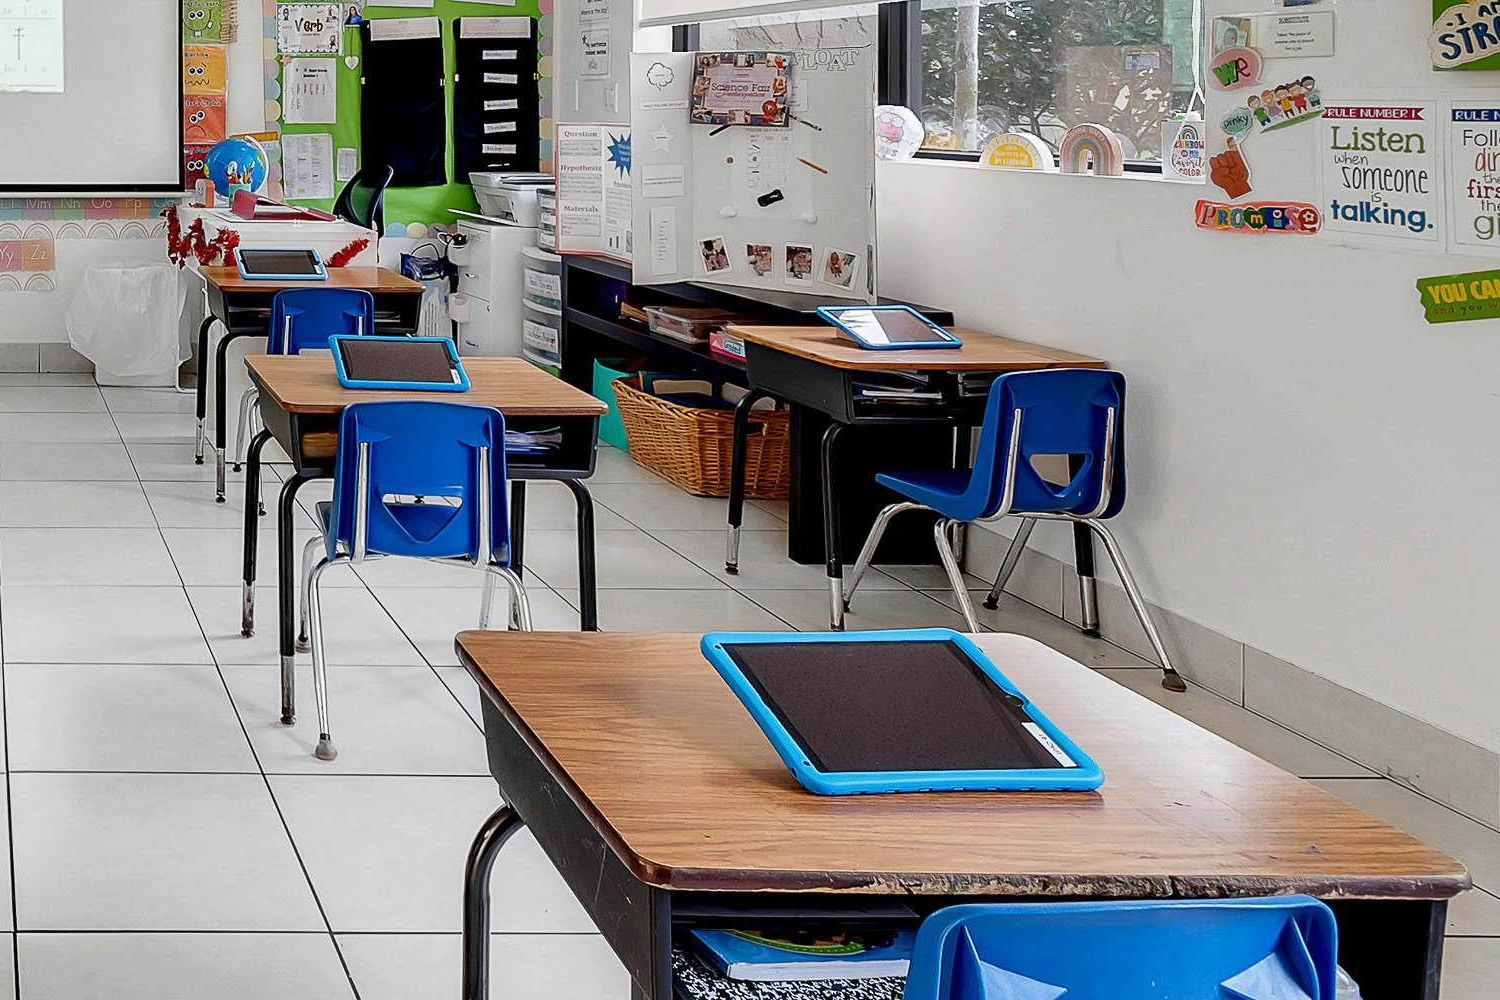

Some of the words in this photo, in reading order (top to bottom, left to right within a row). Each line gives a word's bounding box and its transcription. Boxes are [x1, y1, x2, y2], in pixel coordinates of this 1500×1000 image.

[294, 17, 324, 33] Verb
[711, 82, 750, 93] Science
[751, 83, 771, 93] Fair
[1327, 109, 1358, 119] RULE
[1359, 109, 1411, 119] NUMBER
[1455, 110, 1483, 121] RULE
[1222, 113, 1249, 131] pinky
[1329, 125, 1427, 154] Listen
[1333, 151, 1369, 166] when
[1342, 166, 1429, 194] someone
[1370, 190, 1382, 203] is
[1330, 199, 1435, 233] talking.
[1427, 283, 1467, 305] YOU
[1432, 304, 1455, 315] and
[1461, 303, 1483, 316] you
